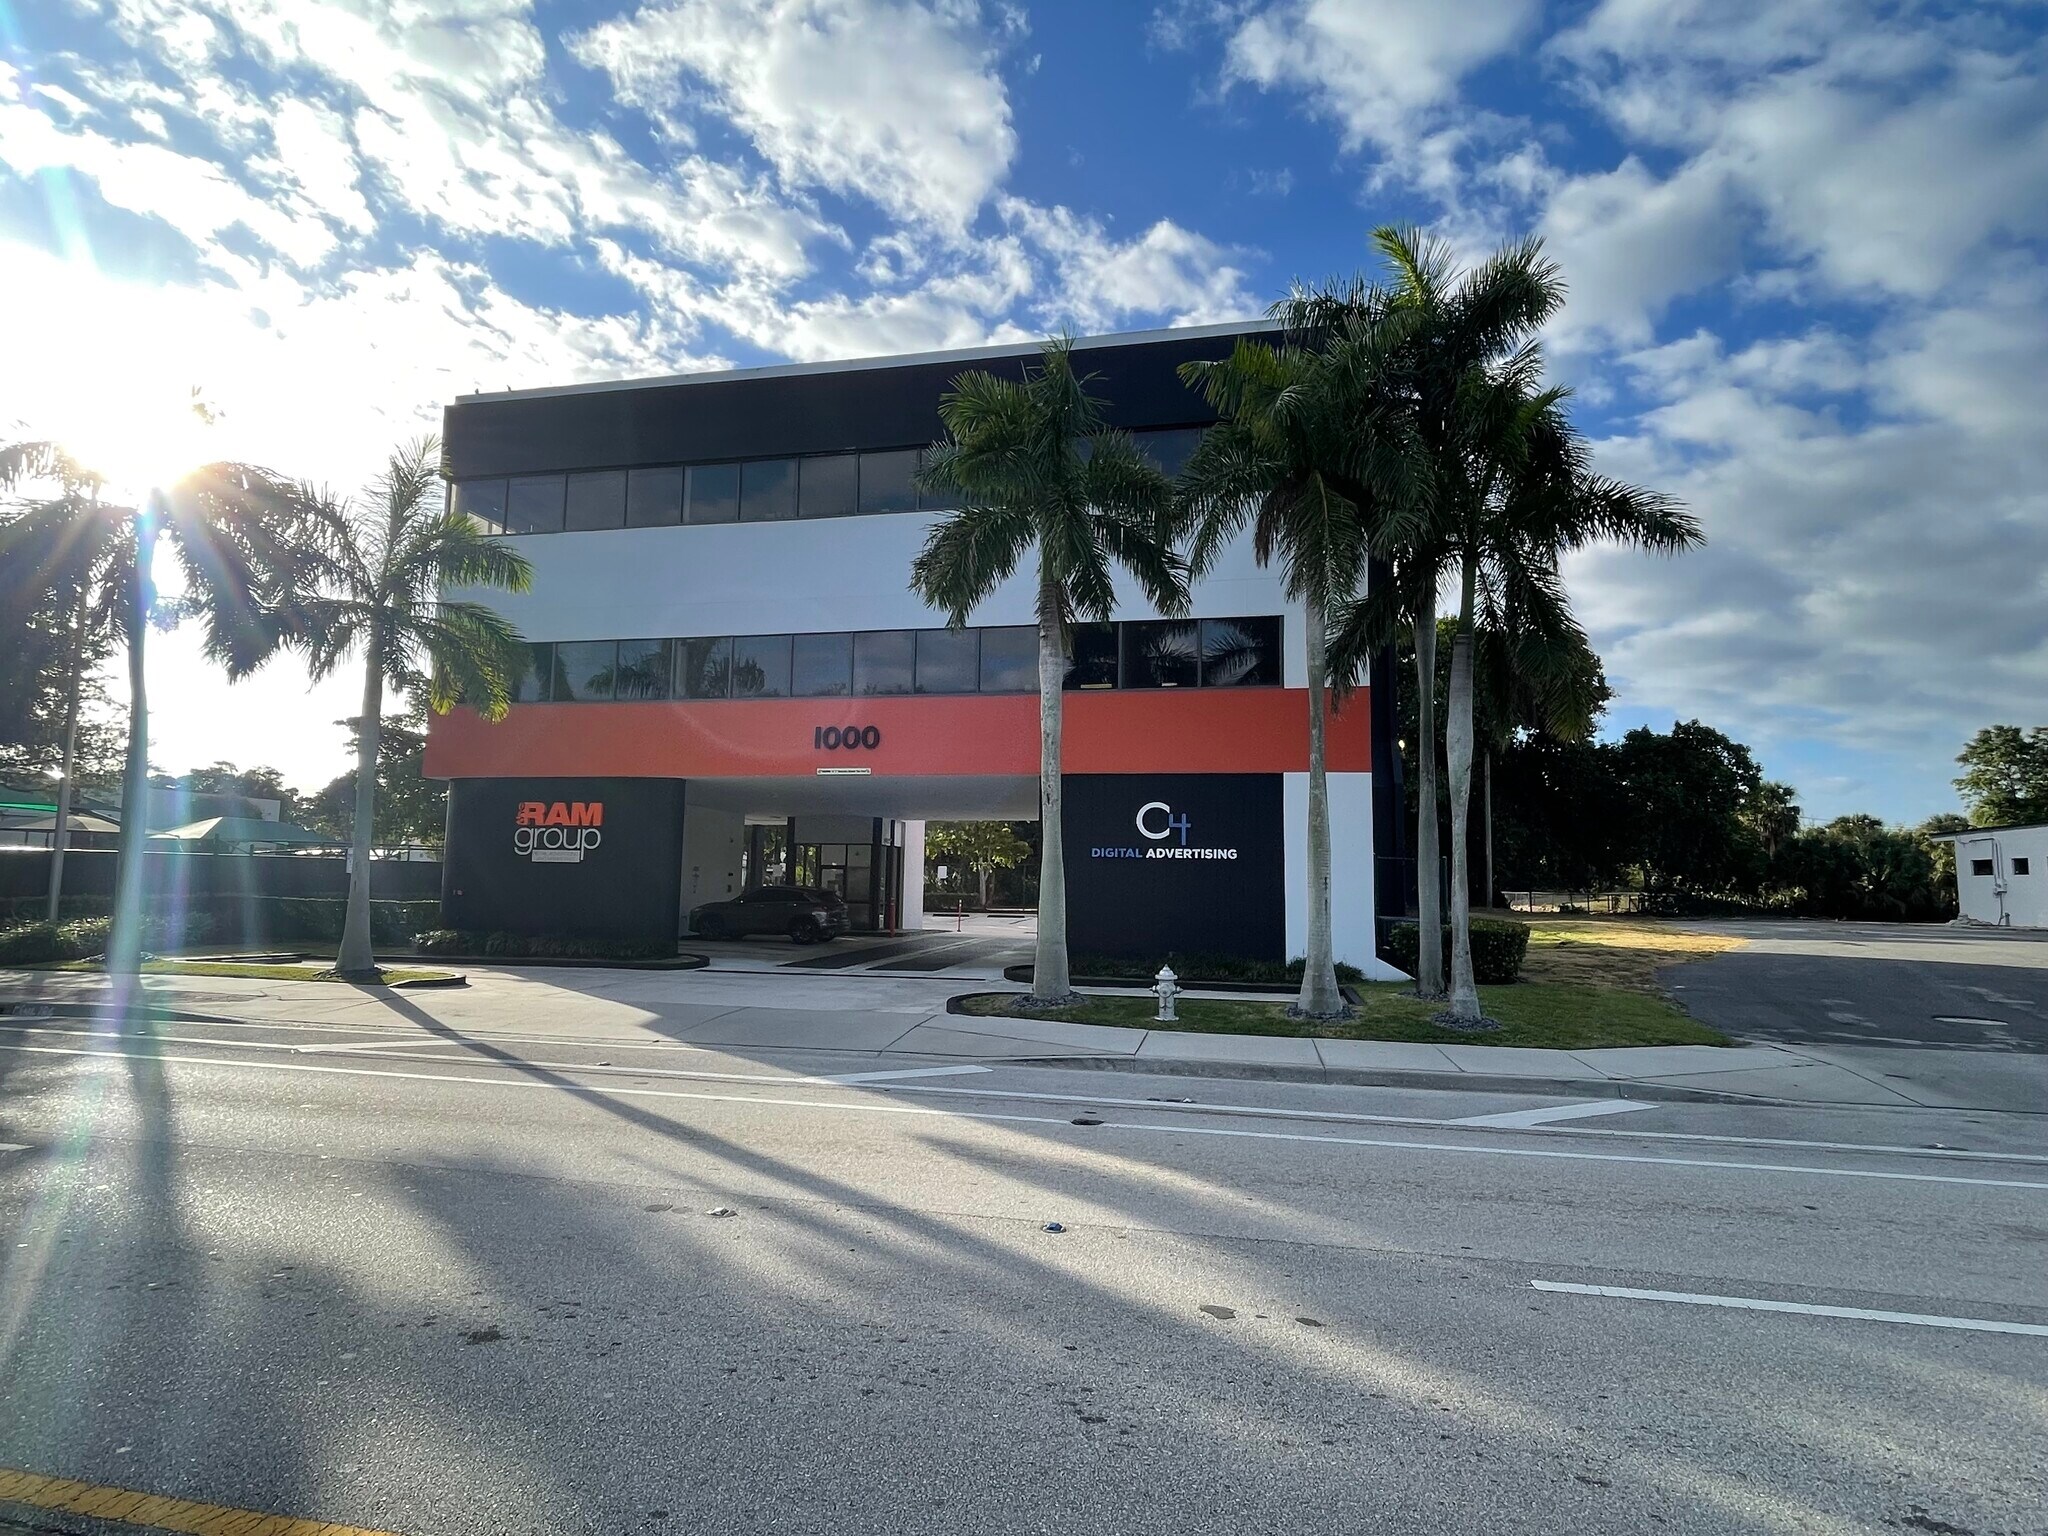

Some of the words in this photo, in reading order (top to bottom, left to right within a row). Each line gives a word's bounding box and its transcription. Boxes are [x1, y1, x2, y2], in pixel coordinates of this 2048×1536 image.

[814, 726, 880, 750] 1000
[524, 802, 604, 826] RAM
[514, 827, 601, 861] group
[1091, 847, 1143, 858] DIGITAL
[1145, 848, 1238, 860] ADVERTISING
